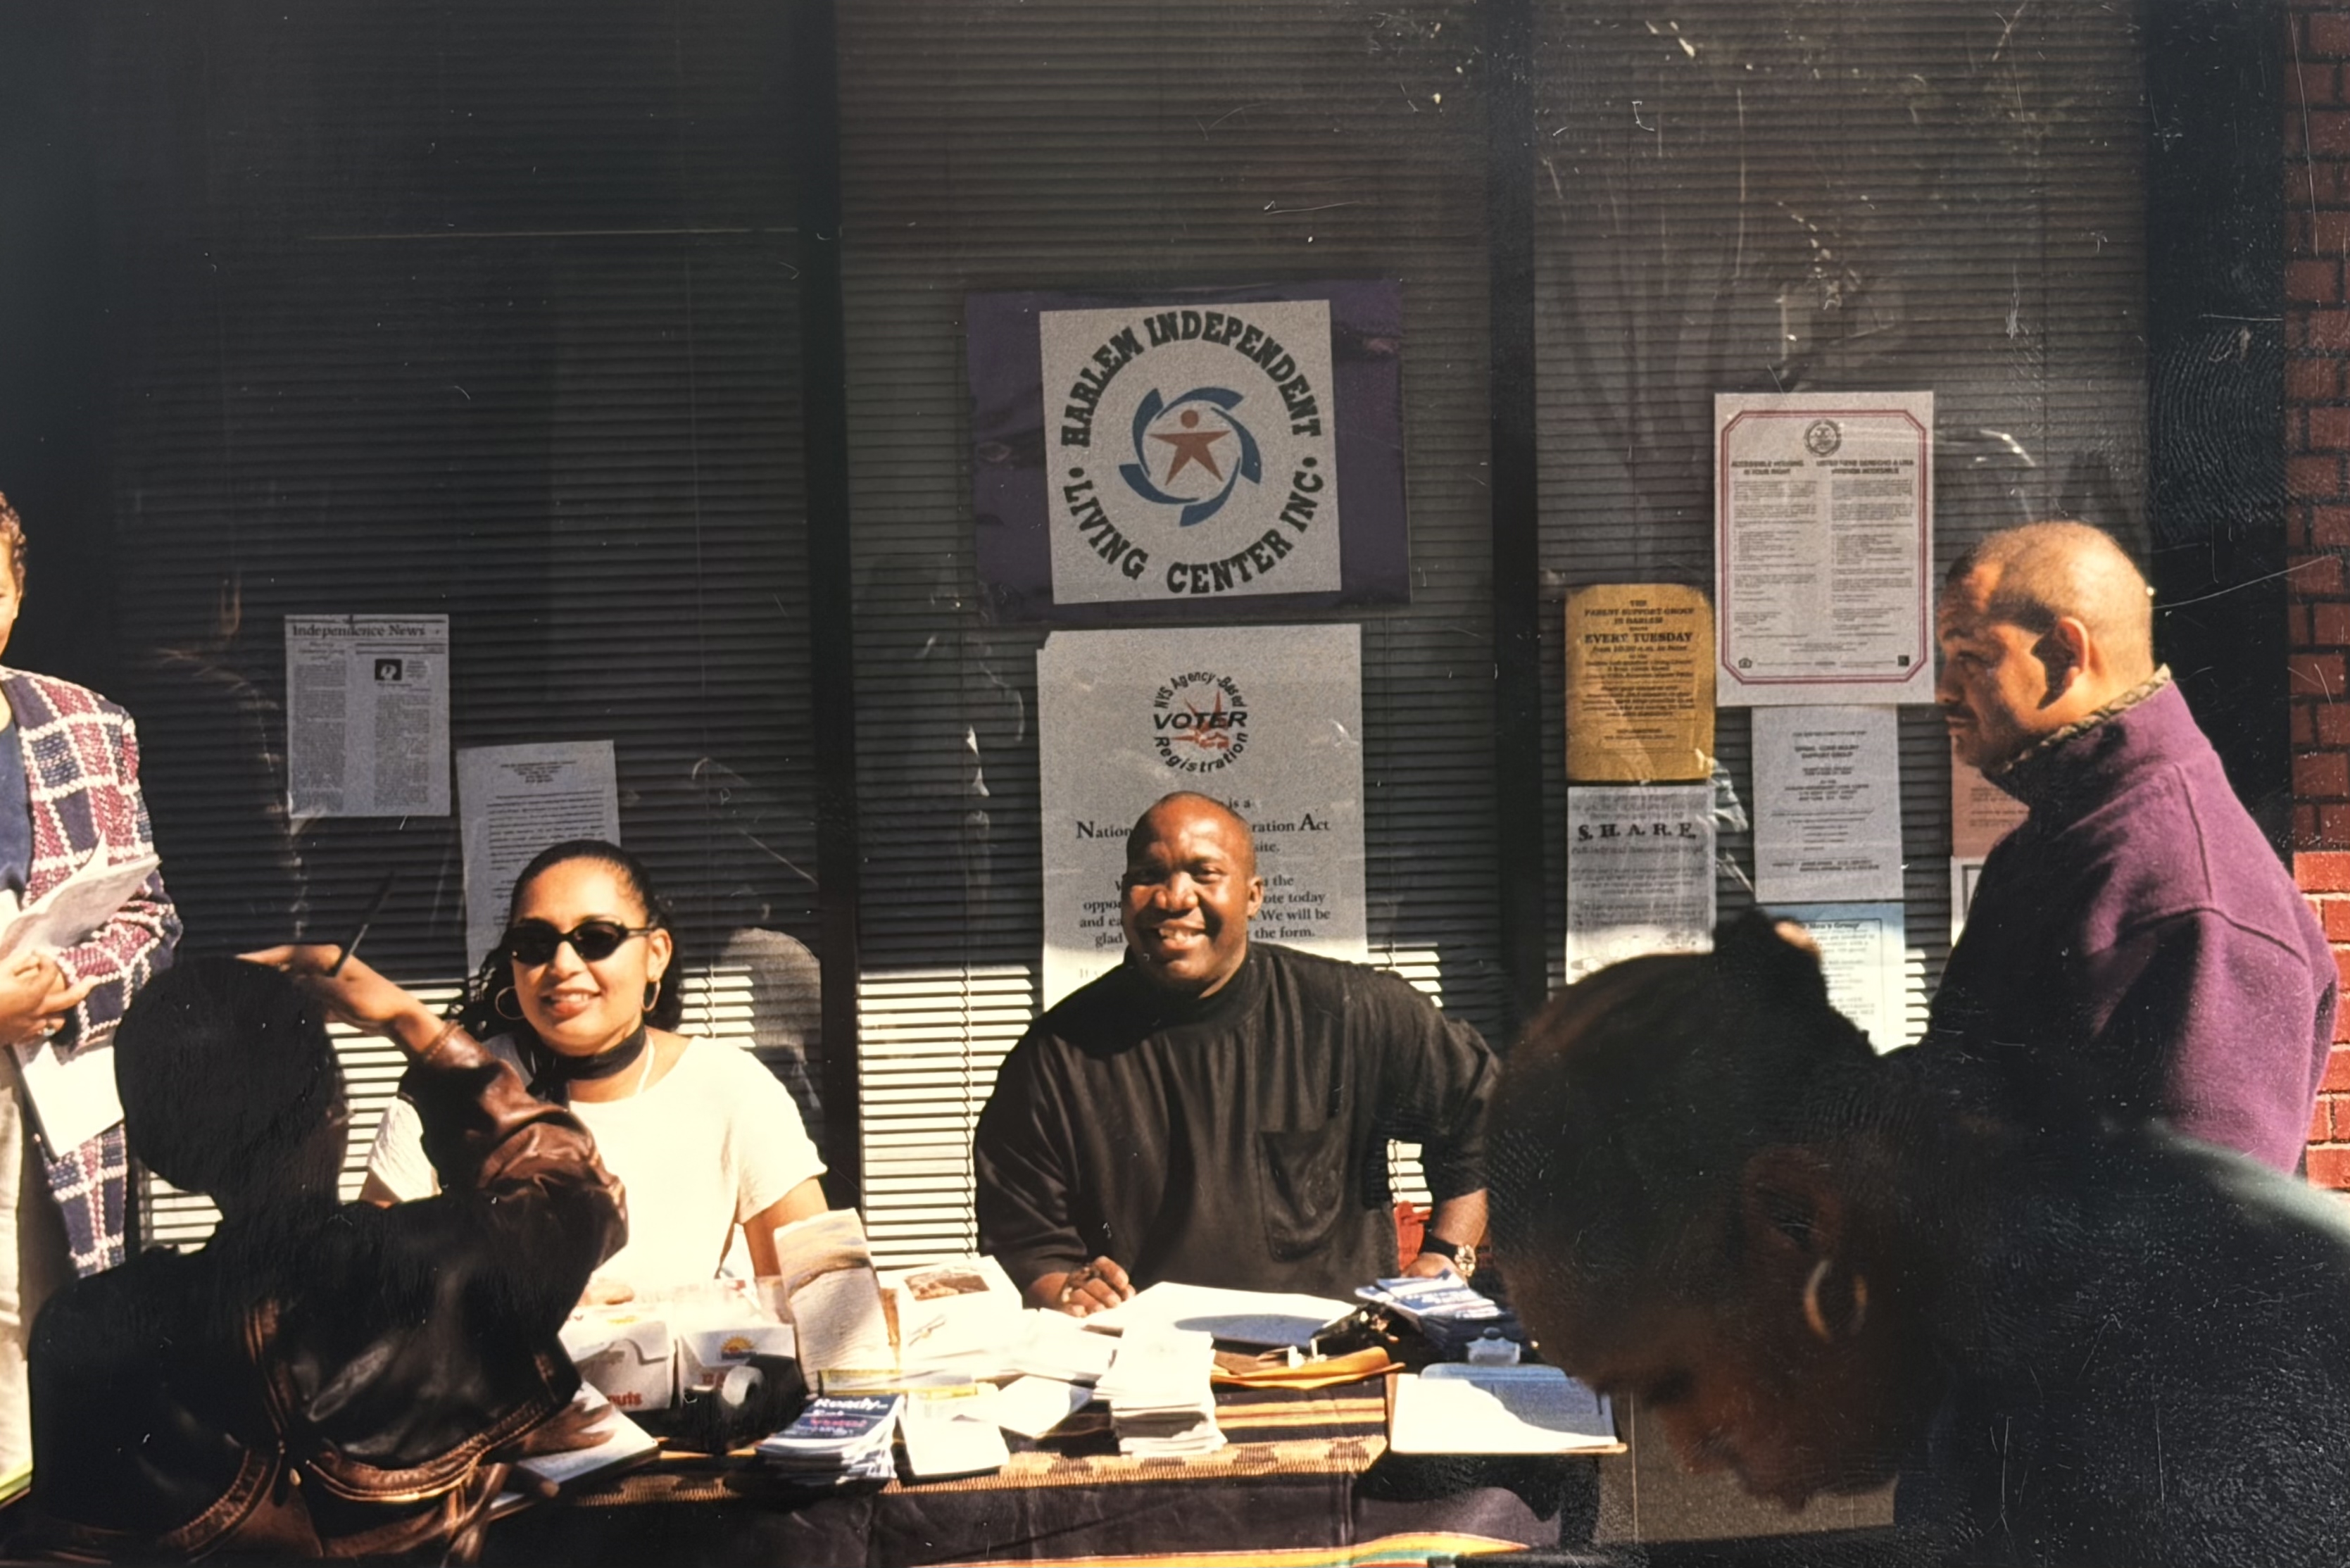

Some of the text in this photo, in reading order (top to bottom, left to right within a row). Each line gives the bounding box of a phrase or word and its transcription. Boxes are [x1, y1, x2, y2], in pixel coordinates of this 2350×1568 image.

[1062, 311, 1321, 447] HARLEM INDEPENDENT
[1064, 479, 1149, 580] LIVING
[1167, 529, 1293, 594] CENTER
[293, 624, 425, 639] Independence News
[1585, 632, 1693, 644] EVERY TUESDAY
[1154, 686, 1174, 708] NYS
[1153, 711, 1248, 729] VOTER
[1153, 732, 1248, 772] Registration
[1244, 800, 1251, 808] a
[1076, 813, 1330, 839] Nation ration Act
[1273, 875, 1294, 886] the
[1264, 893, 1284, 903] ote
[1288, 891, 1326, 907] today
[1079, 916, 1104, 928] and
[1261, 910, 1283, 921] We
[1286, 909, 1311, 920] will
[1315, 908, 1331, 920] be
[1095, 927, 1316, 948] glad the form.
[607, 1392, 643, 1406] nuts
